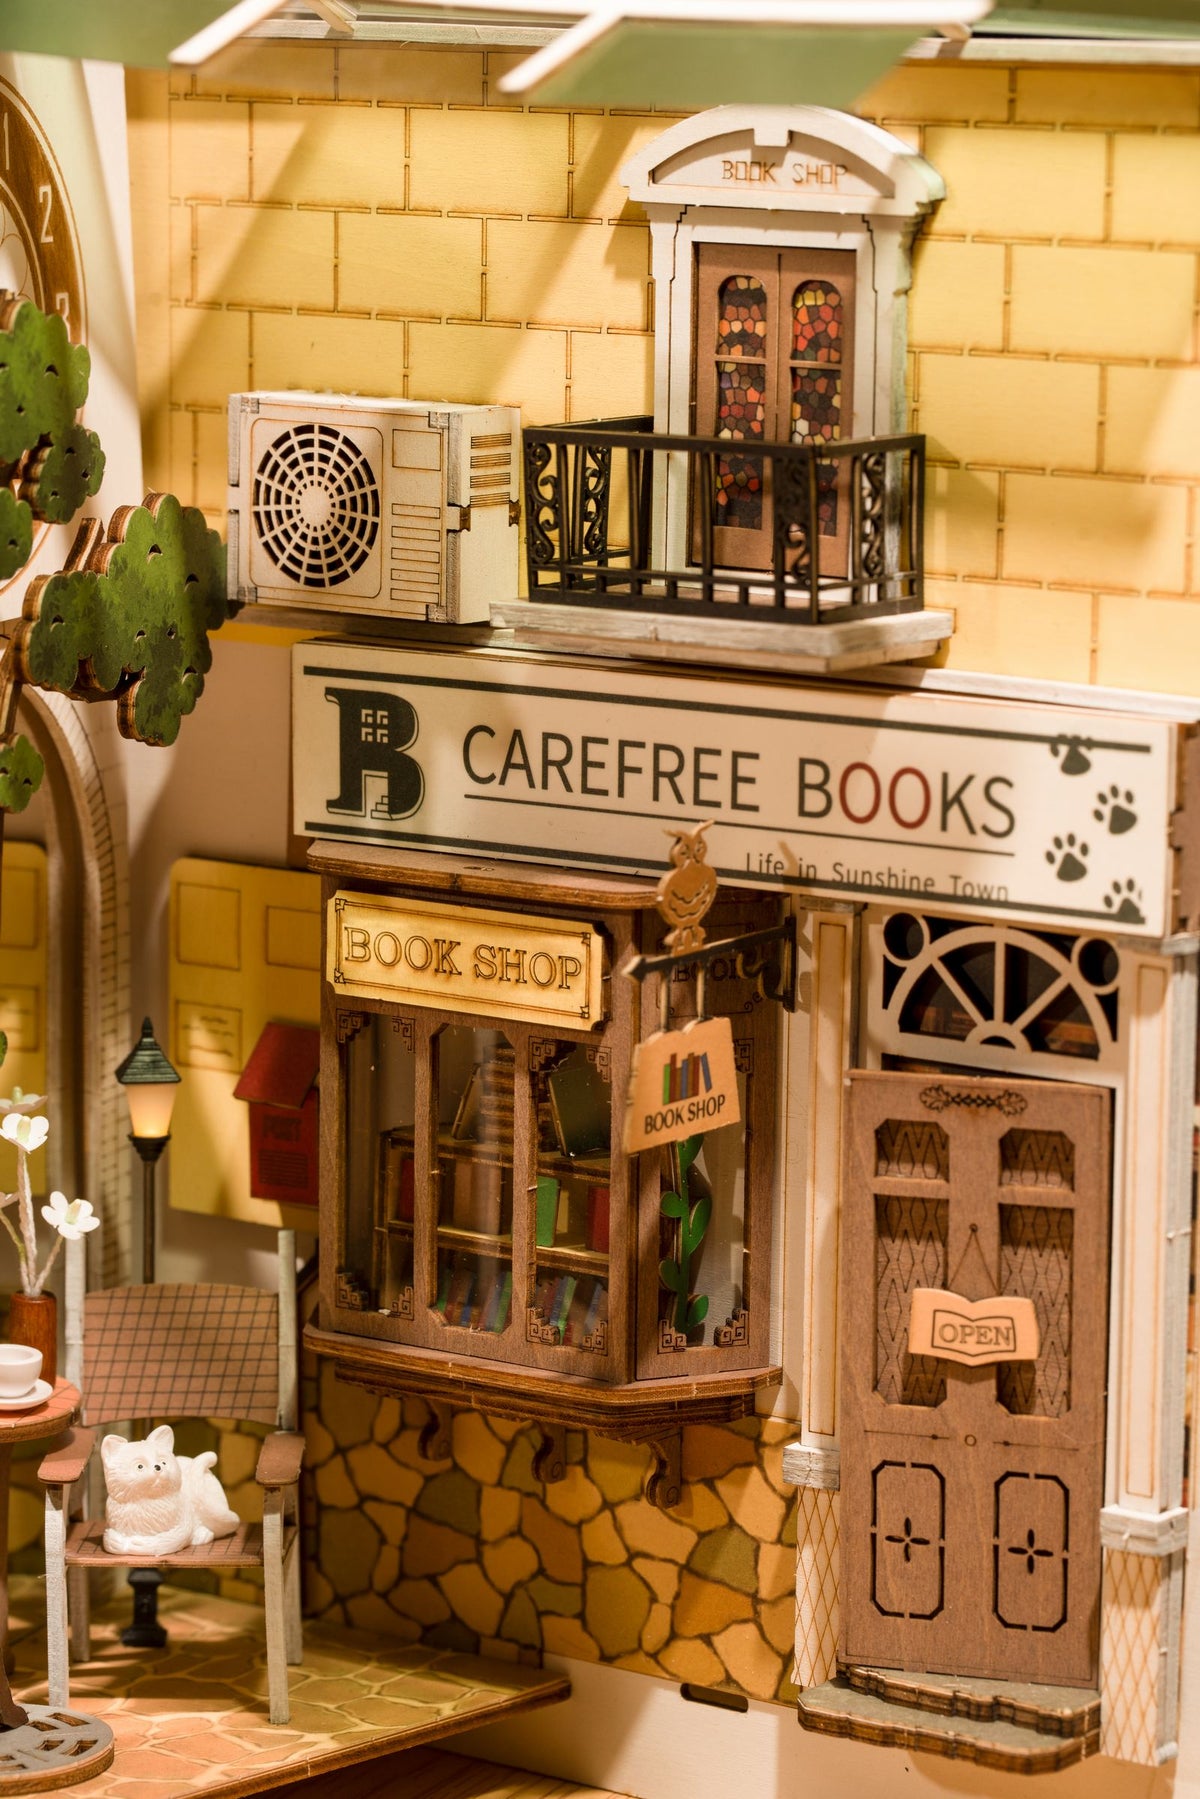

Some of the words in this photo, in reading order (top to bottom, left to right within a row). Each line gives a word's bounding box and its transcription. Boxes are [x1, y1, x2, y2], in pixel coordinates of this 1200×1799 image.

[721, 160, 777, 183] BOOK
[792, 162, 849, 185] SHOP
[39, 184, 54, 244] 2
[462, 724, 760, 813] CAREFREE
[797, 757, 1016, 839] BOOKS
[745, 853, 785, 877] Life
[798, 857, 818, 881] in
[832, 862, 936, 894] Sunshine
[949, 875, 1010, 902] Town
[344, 926, 462, 976] BOOK
[474, 944, 582, 990] SHOP
[644, 1105, 685, 1135] BOOK
[687, 1094, 726, 1122] SHOP
[938, 1323, 1012, 1346] OPEN
